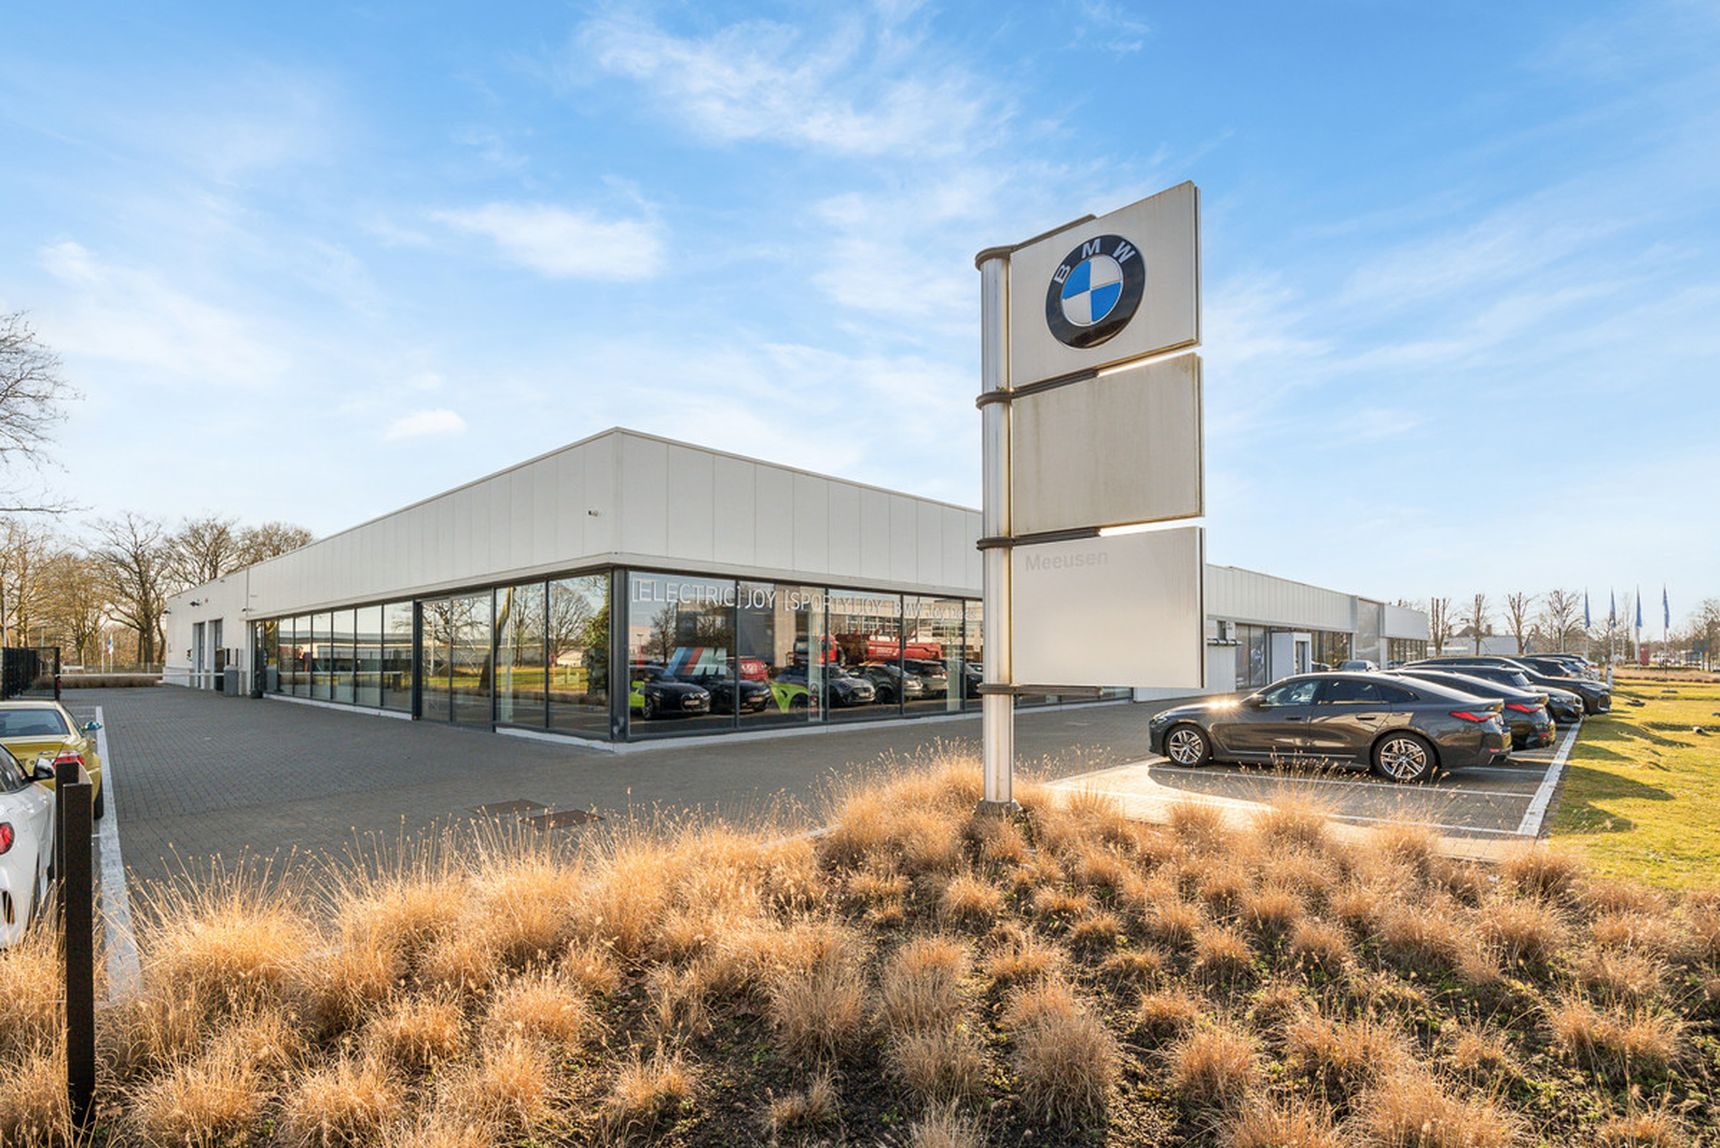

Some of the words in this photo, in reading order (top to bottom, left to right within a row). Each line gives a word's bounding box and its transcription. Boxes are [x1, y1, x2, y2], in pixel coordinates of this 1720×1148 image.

[1053, 238, 1136, 284] BMW
[1025, 552, 1108, 571] Meeusen
[632, 577, 741, 609] [ELECTRIC]
[745, 588, 776, 609] JOY
